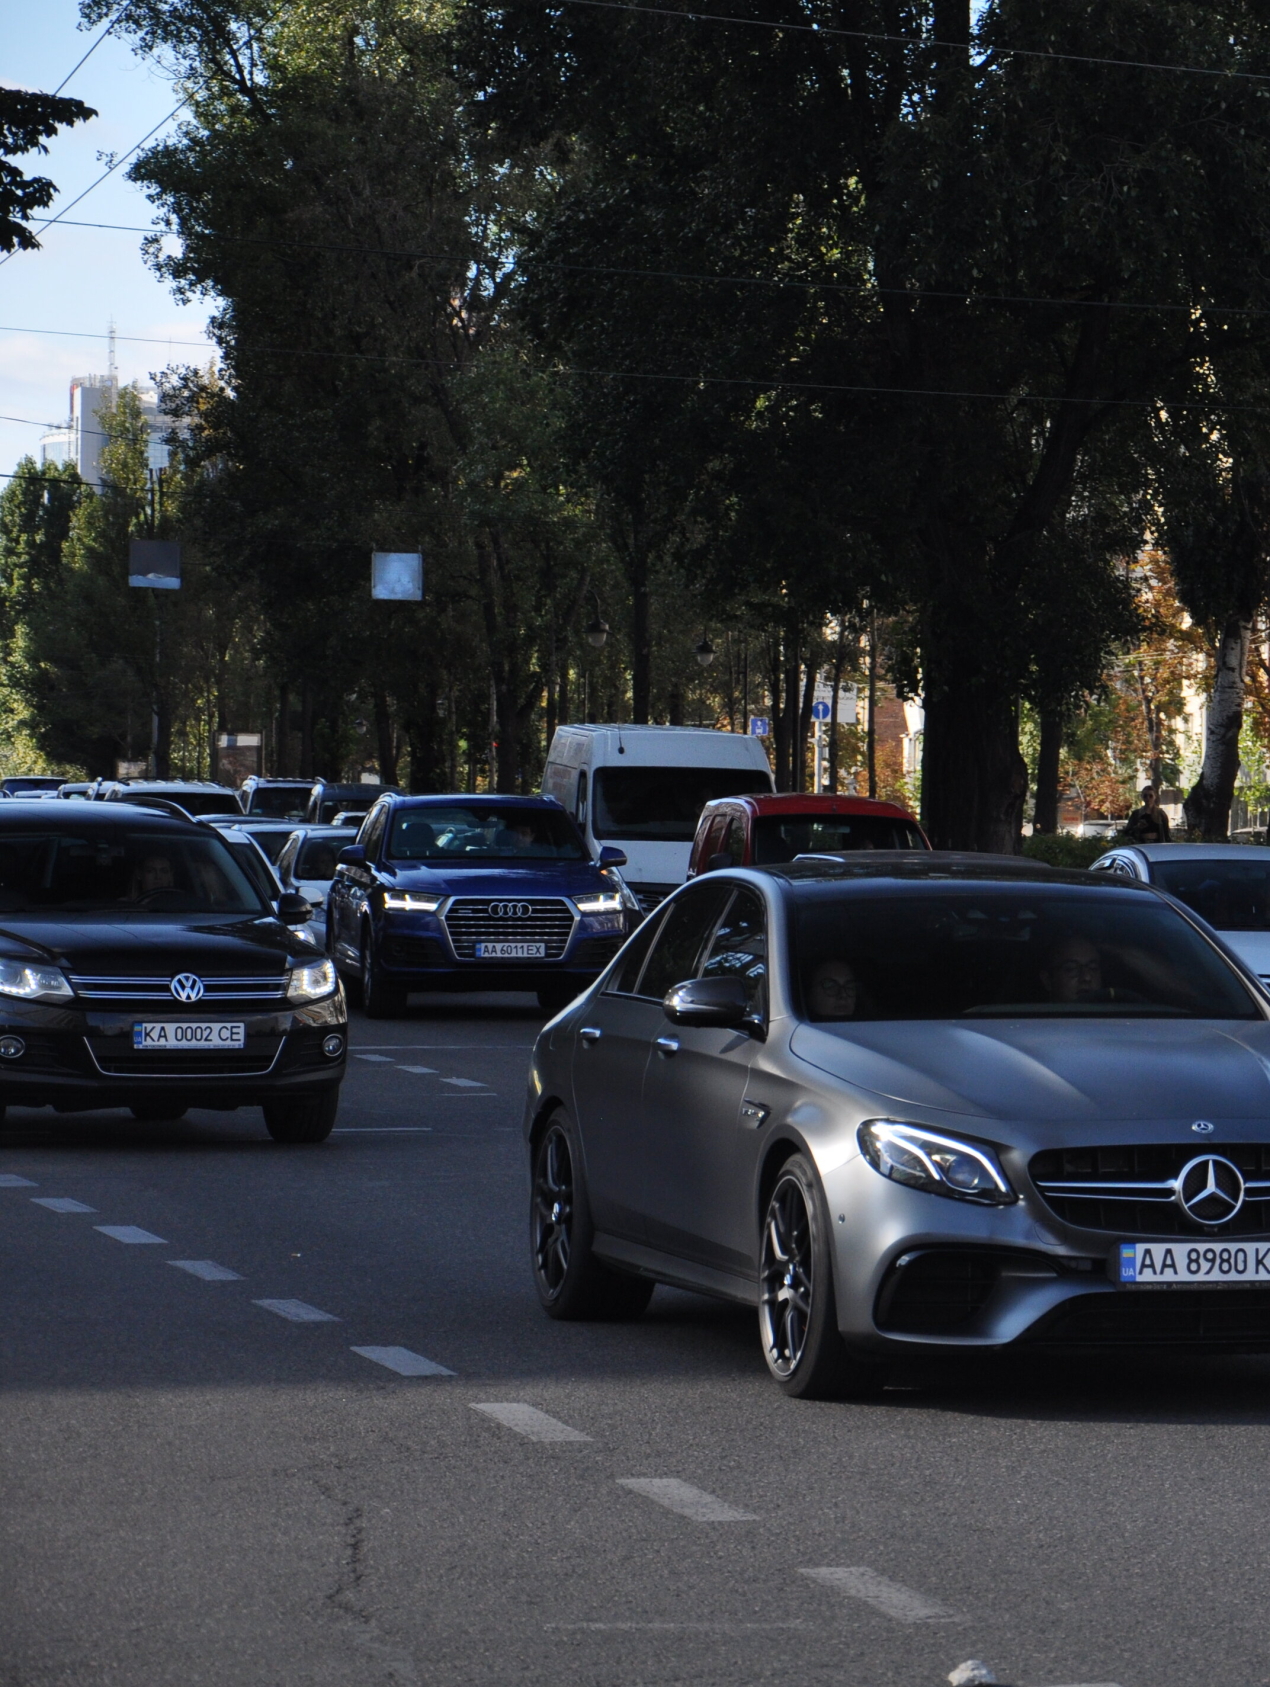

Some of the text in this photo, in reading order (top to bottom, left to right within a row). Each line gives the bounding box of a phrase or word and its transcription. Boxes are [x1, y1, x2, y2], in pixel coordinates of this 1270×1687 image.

[482, 945, 541, 955] AA 6011 EX
[144, 1026, 241, 1042] KA 0002 CE
[1138, 1248, 1178, 1275] AA
[1186, 1248, 1248, 1275] 8980
[1122, 1268, 1134, 1276] UA
